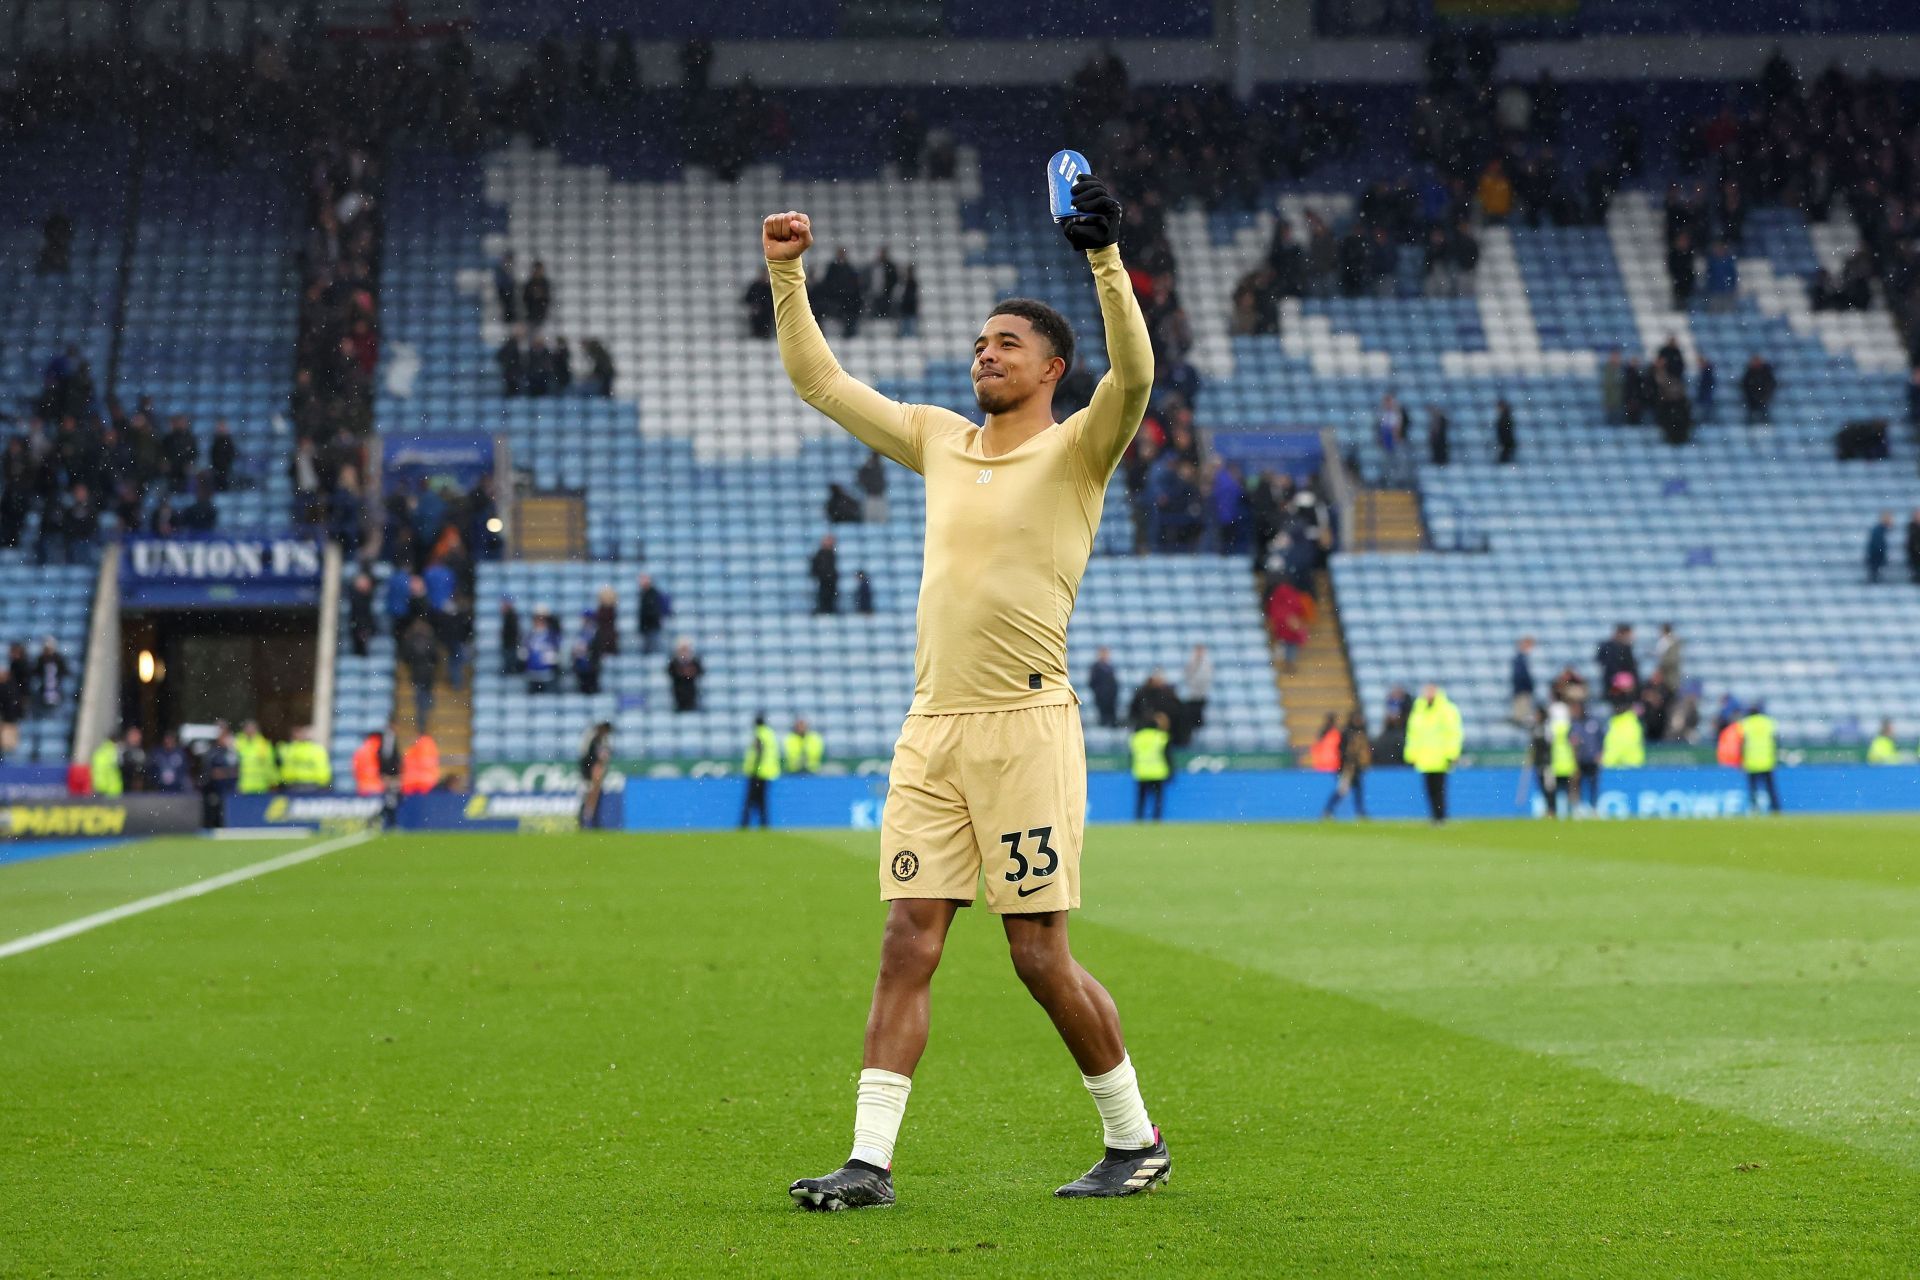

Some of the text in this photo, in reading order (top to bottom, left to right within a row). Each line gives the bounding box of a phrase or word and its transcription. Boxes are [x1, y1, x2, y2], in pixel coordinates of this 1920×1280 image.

[976, 469, 993, 484] 20
[133, 541, 263, 578] UNION
[1001, 826, 1058, 882] 33
